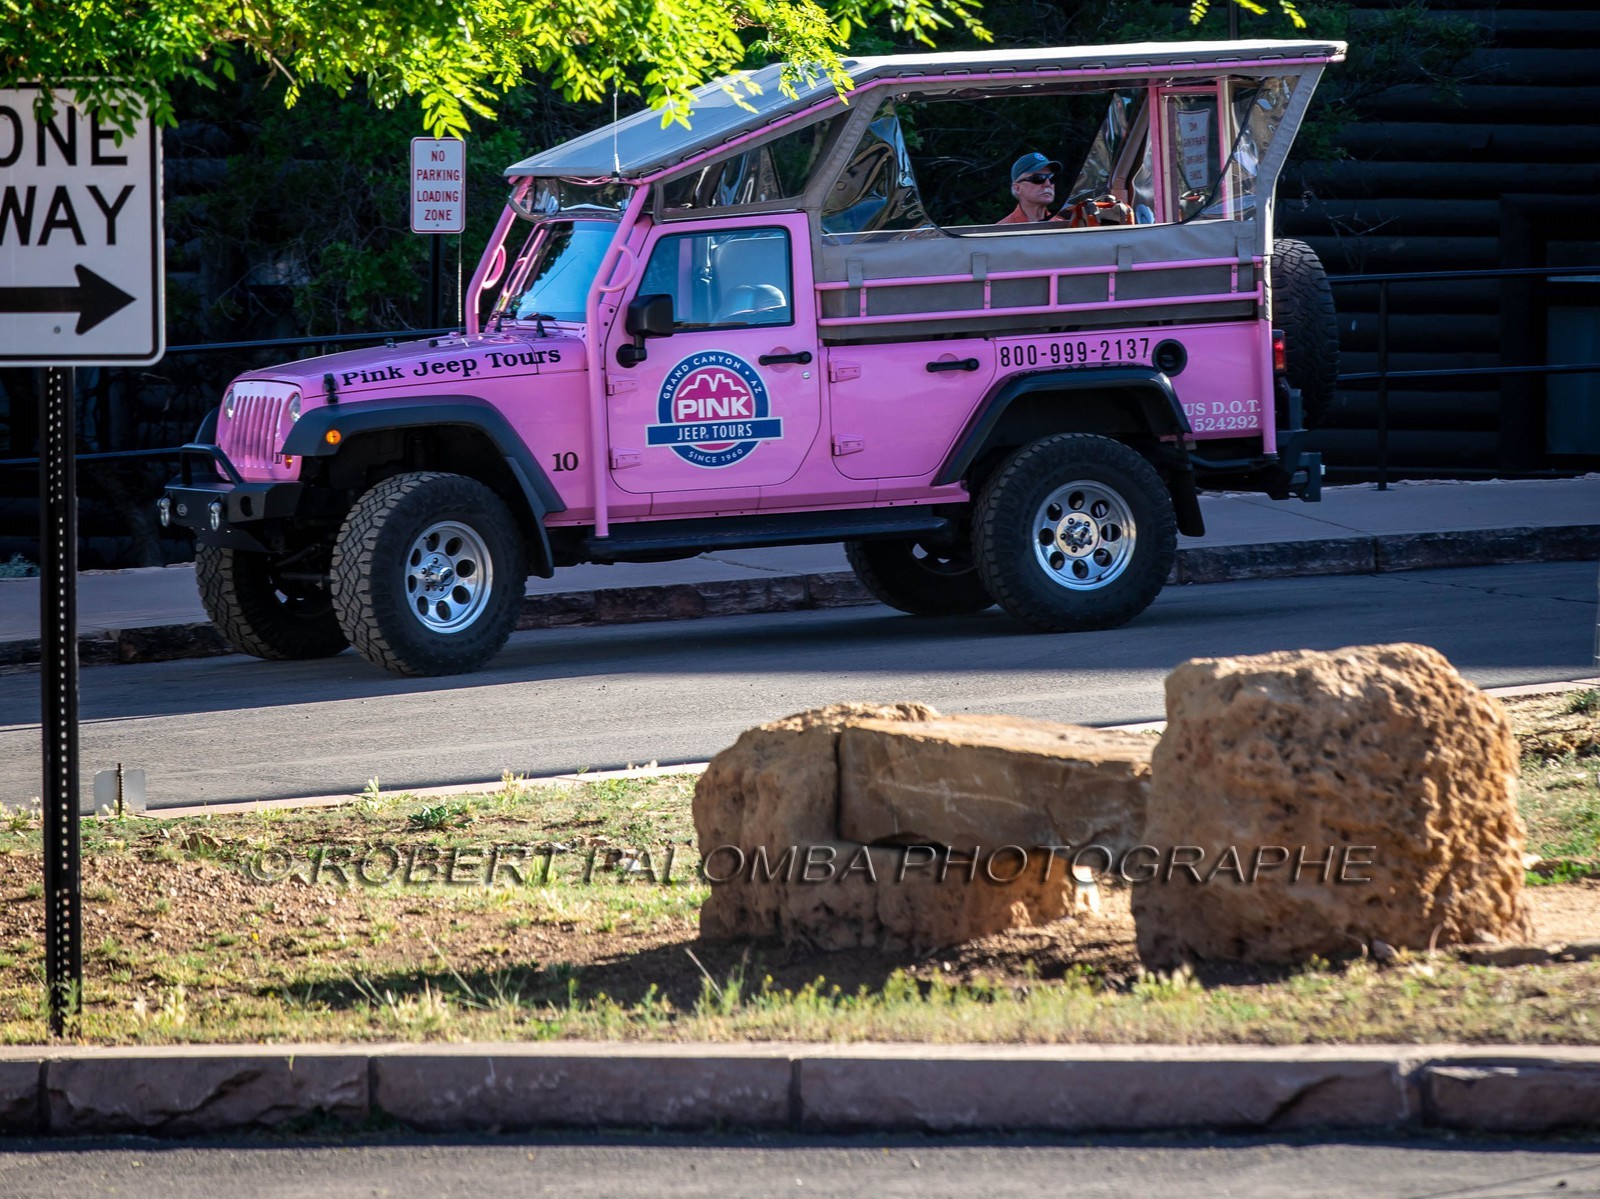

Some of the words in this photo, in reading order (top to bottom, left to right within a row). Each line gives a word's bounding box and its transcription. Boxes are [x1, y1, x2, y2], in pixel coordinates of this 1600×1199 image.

[0, 104, 128, 167] ONE
[431, 150, 445, 162] NO
[417, 169, 460, 181] PARKING
[417, 190, 459, 203] LOADING
[0, 184, 136, 246] WAY
[424, 209, 453, 221] ZONE
[1000, 338, 1150, 367] 800-999-2137
[342, 365, 406, 386] Pink
[413, 357, 478, 377] Jeep
[485, 349, 562, 368] Tours
[663, 364, 689, 399] GRAND
[693, 355, 741, 369] CANYON
[751, 380, 762, 394] AZ
[677, 395, 750, 419] PINK
[1183, 403, 1206, 416] US
[1211, 399, 1262, 415] D.O.T.
[677, 426, 706, 441] JEEP
[712, 423, 753, 438] TOURS
[1188, 415, 1259, 432] 524292
[552, 451, 579, 472] 10
[688, 450, 717, 463] SINCE
[721, 448, 744, 461] 1960
